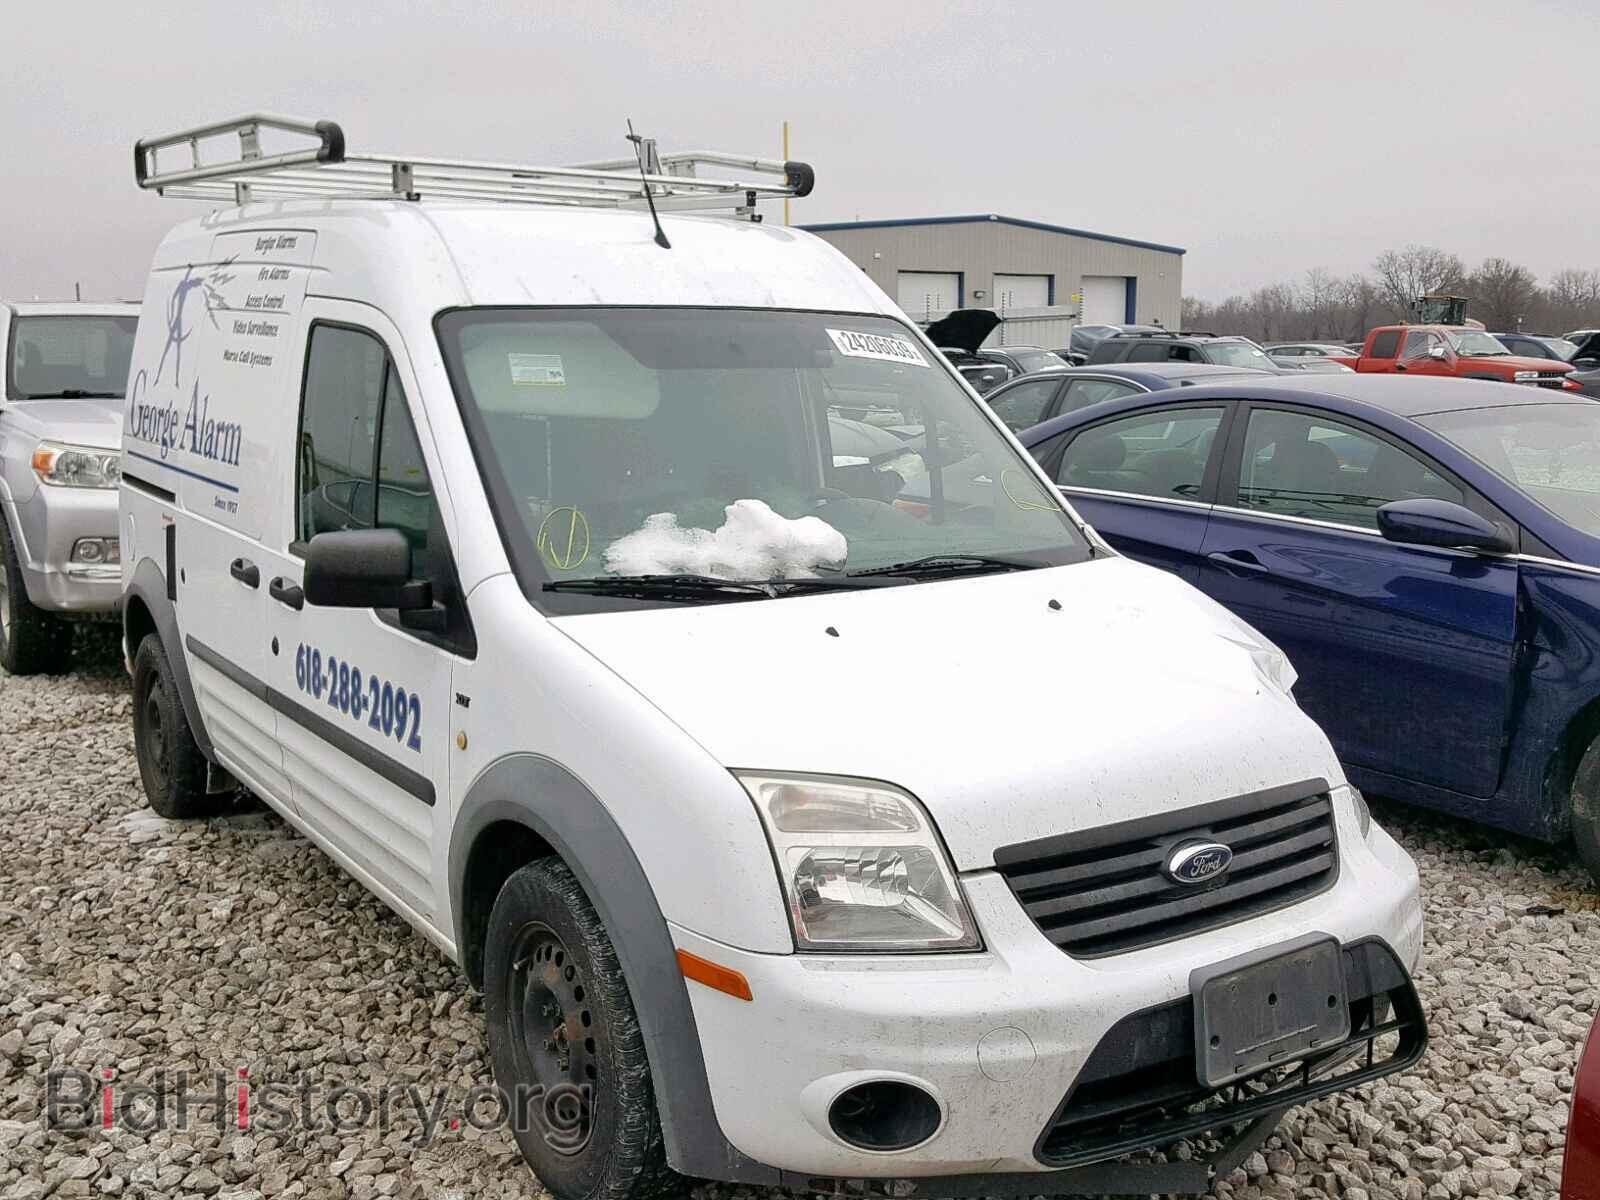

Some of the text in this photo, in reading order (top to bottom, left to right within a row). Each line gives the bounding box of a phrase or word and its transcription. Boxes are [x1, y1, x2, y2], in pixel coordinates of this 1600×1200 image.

[276, 236, 298, 249] Alarms
[269, 267, 290, 280] Alarms
[263, 294, 285, 308] Control
[233, 320, 278, 337] Video Surveillance
[839, 331, 914, 359] 24206039
[239, 350, 250, 364] Call
[250, 352, 273, 368] Systems
[131, 369, 242, 466] George Alarm
[296, 642, 421, 754] 618-288-2092
[1190, 853, 1221, 876] Ford
